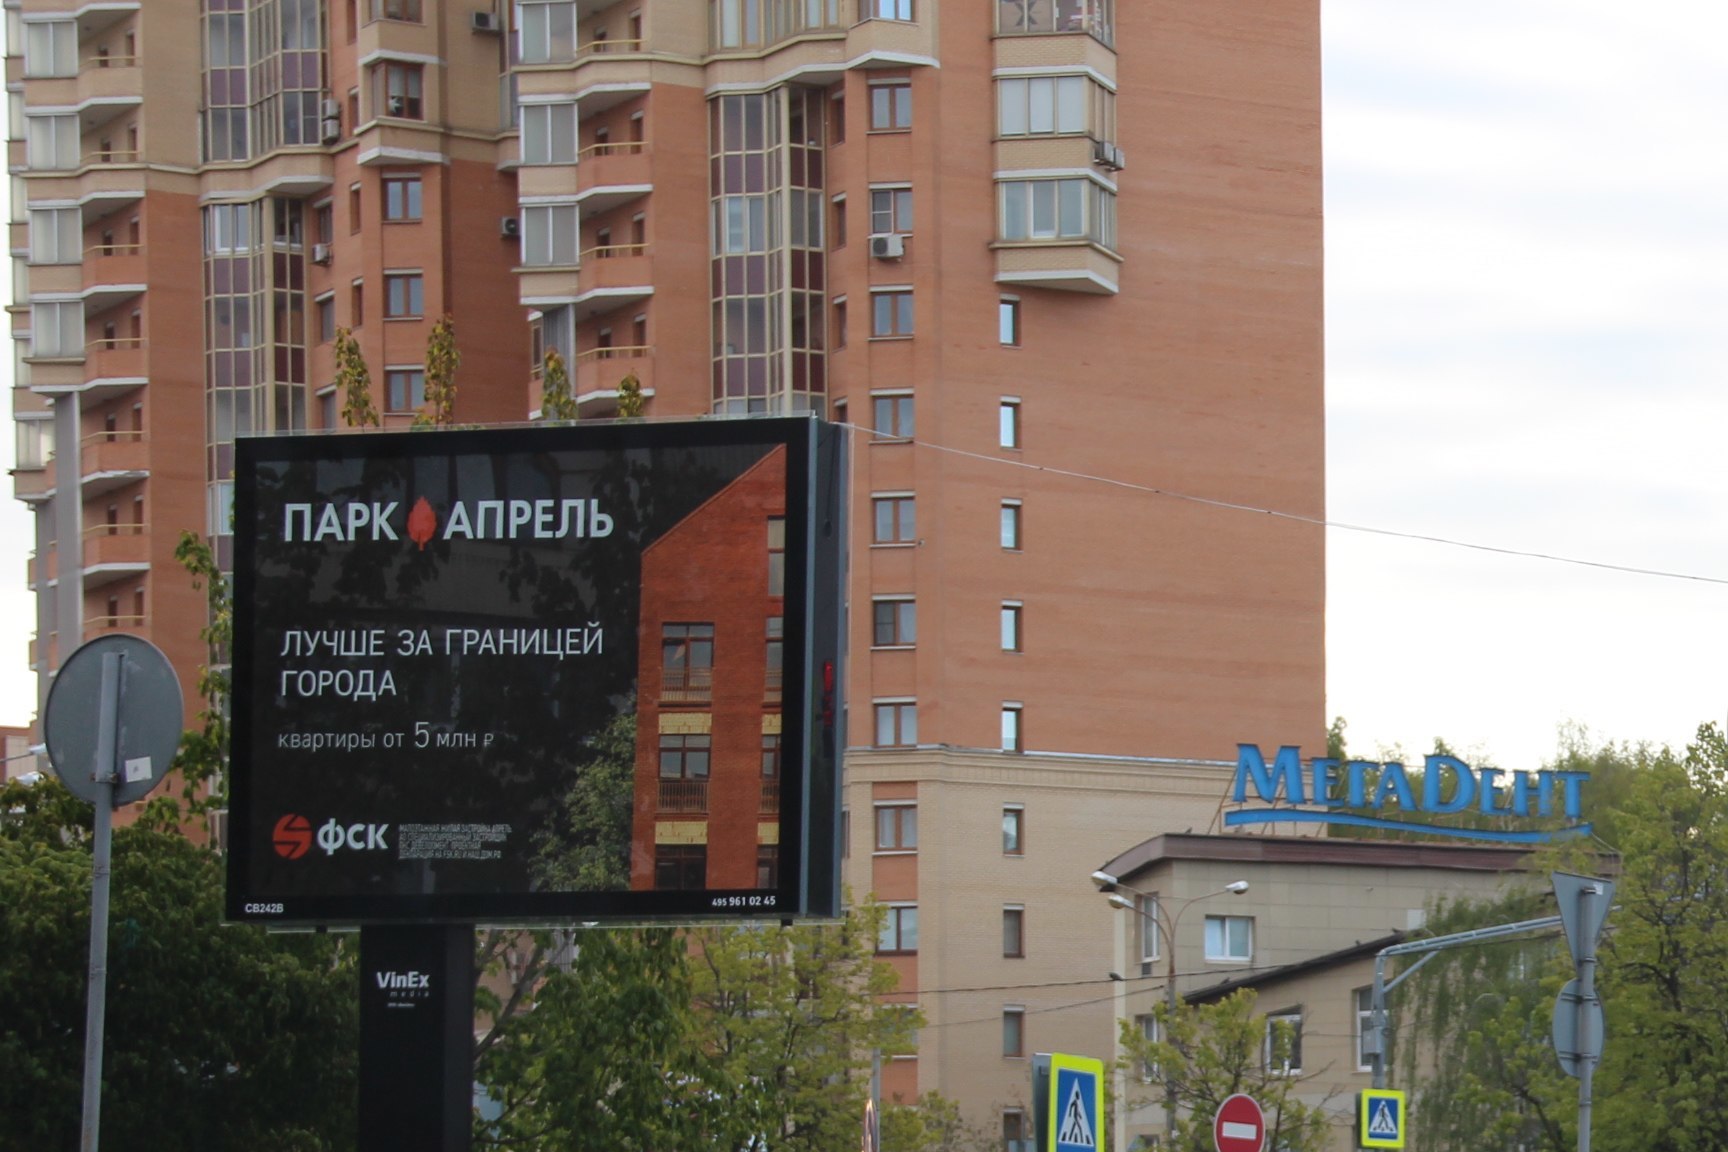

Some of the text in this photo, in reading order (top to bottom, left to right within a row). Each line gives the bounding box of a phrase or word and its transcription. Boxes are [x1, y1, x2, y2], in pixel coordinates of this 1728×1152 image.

[285, 498, 614, 542] ПАРК АПРЕЛЬ
[281, 622, 603, 661] ЛУЧШЕ ЗА ГРАНИЦЕЙ
[281, 669, 397, 702] ГОРОДА
[278, 733, 376, 752] квартиры
[383, 733, 405, 748] от
[415, 721, 430, 748] 5
[436, 733, 477, 747] млн
[712, 896, 776, 906] 495 961 02 45
[376, 970, 430, 988] VinEx
